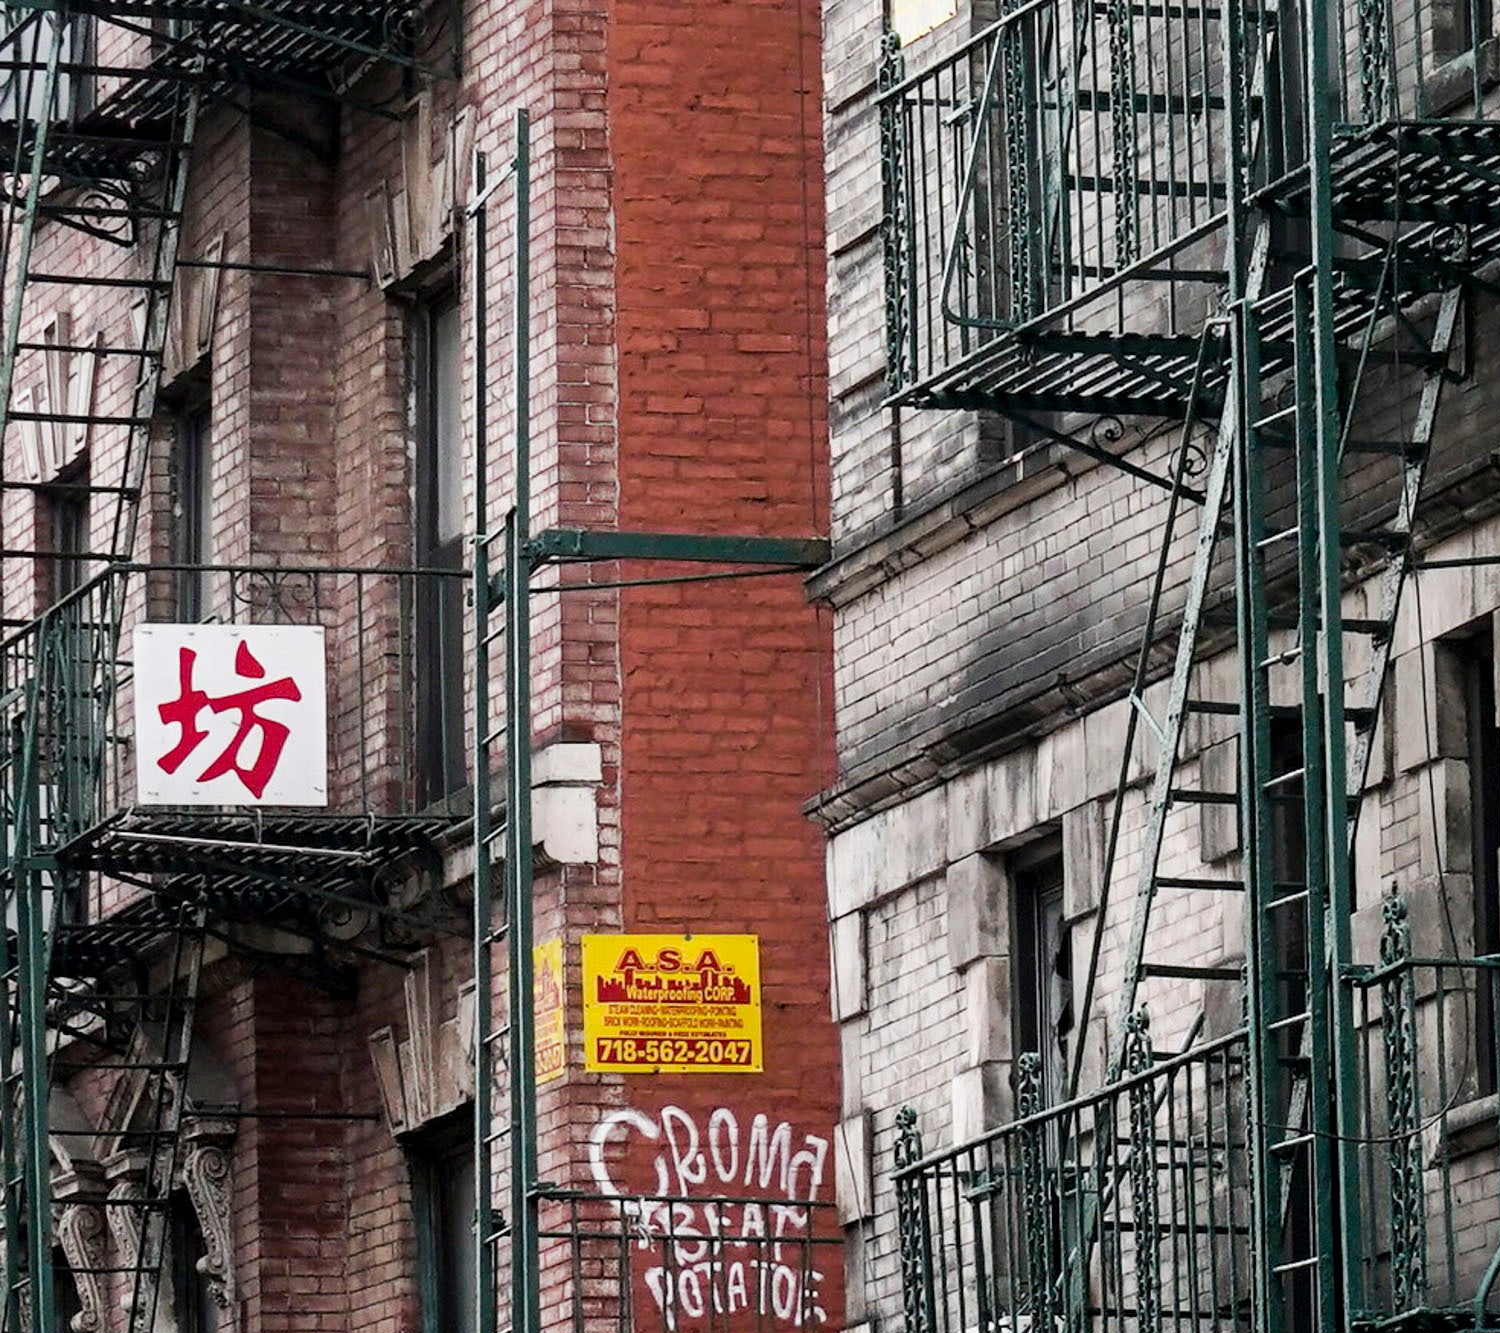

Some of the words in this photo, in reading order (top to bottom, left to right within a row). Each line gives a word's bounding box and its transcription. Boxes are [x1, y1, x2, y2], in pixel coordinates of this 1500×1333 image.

[157, 638, 303, 800] 坊
[614, 946, 735, 974] A.S.A.
[627, 985, 702, 1003] Waterproofing
[706, 984, 736, 1001] CORP.
[599, 1039, 751, 1063] 718-562-2047
